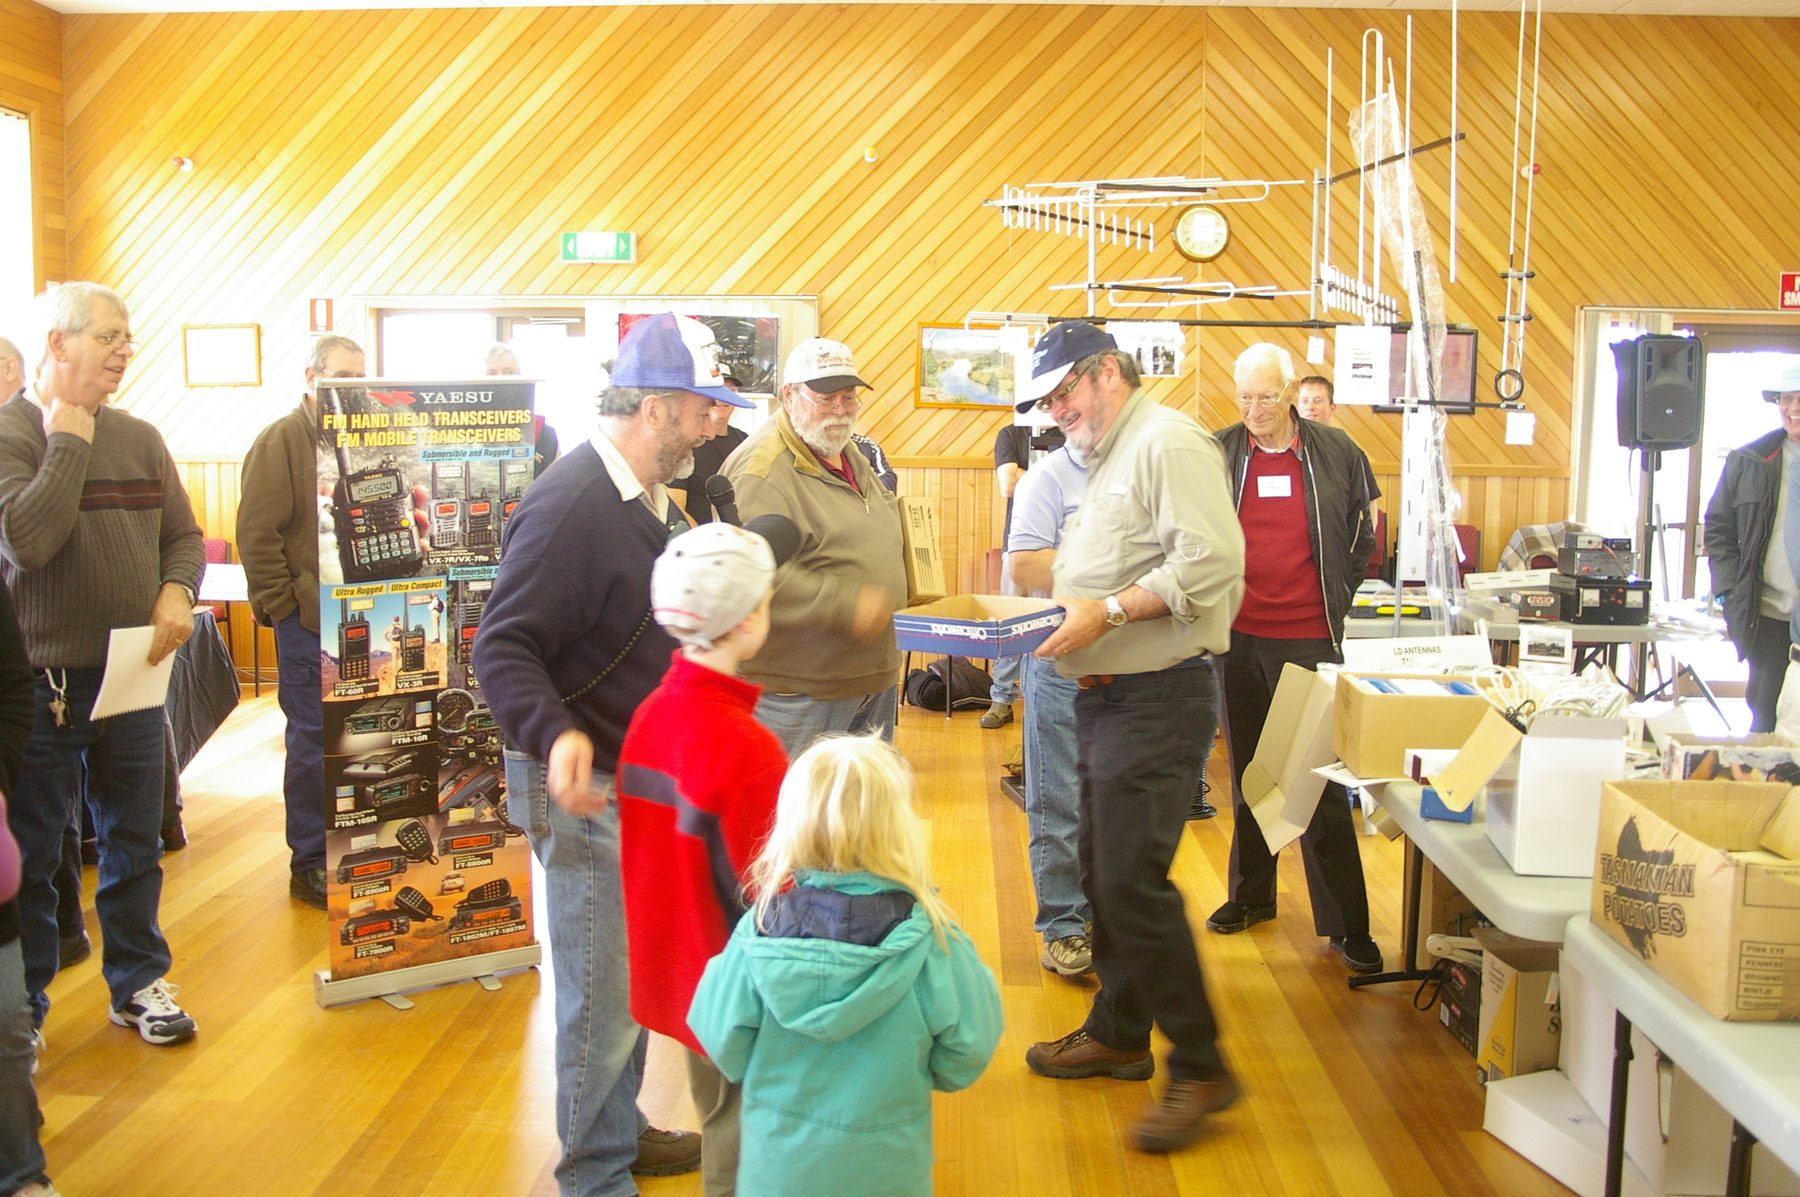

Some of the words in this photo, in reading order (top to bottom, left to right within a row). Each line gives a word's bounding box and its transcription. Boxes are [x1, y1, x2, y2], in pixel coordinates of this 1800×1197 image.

[419, 391, 494, 404] YAESU
[323, 414, 347, 430] FM
[350, 413, 390, 429] HAND
[393, 412, 429, 427] HELD
[432, 409, 532, 426] TRANSCEIVERS
[336, 432, 360, 448] FM
[364, 431, 417, 447] MOBILE
[422, 427, 521, 445] TRANSCEIVERS
[422, 450, 467, 459] Submersible
[469, 449, 482, 457] and
[484, 448, 510, 458] Rugged
[452, 567, 493, 576] Submersible
[335, 588, 355, 597] Ultra
[356, 585, 384, 595] Rugged
[391, 583, 409, 592] Ultra
[411, 579, 443, 591] Compact
[1404, 645, 1441, 655] ANTENNAS
[1601, 853, 1696, 898] TASMANIAN
[1603, 891, 1687, 937] POTATOES
[1746, 946, 1767, 954] PINK
[1769, 947, 1785, 955] EYE
